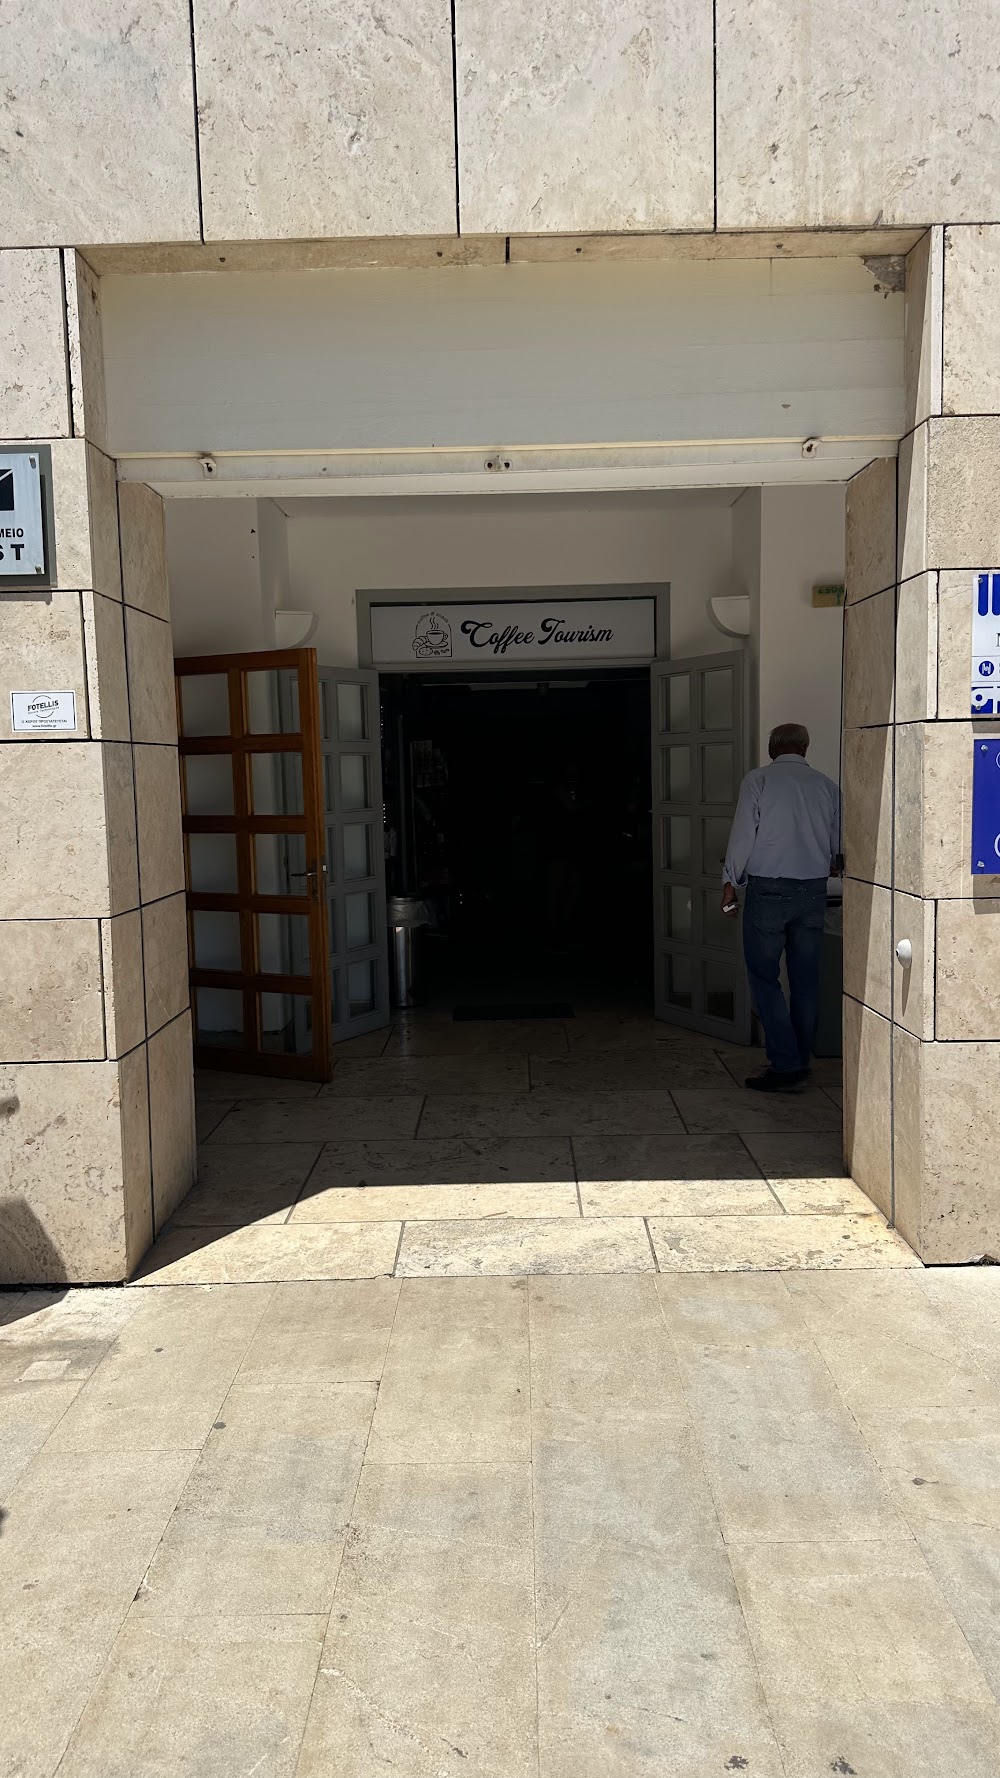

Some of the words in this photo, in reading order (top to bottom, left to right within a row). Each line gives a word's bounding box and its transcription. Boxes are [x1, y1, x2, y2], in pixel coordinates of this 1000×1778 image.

[461, 620, 535, 654] Coffee
[538, 618, 614, 645] Tourism
[28, 700, 59, 711] FOTELLIS
